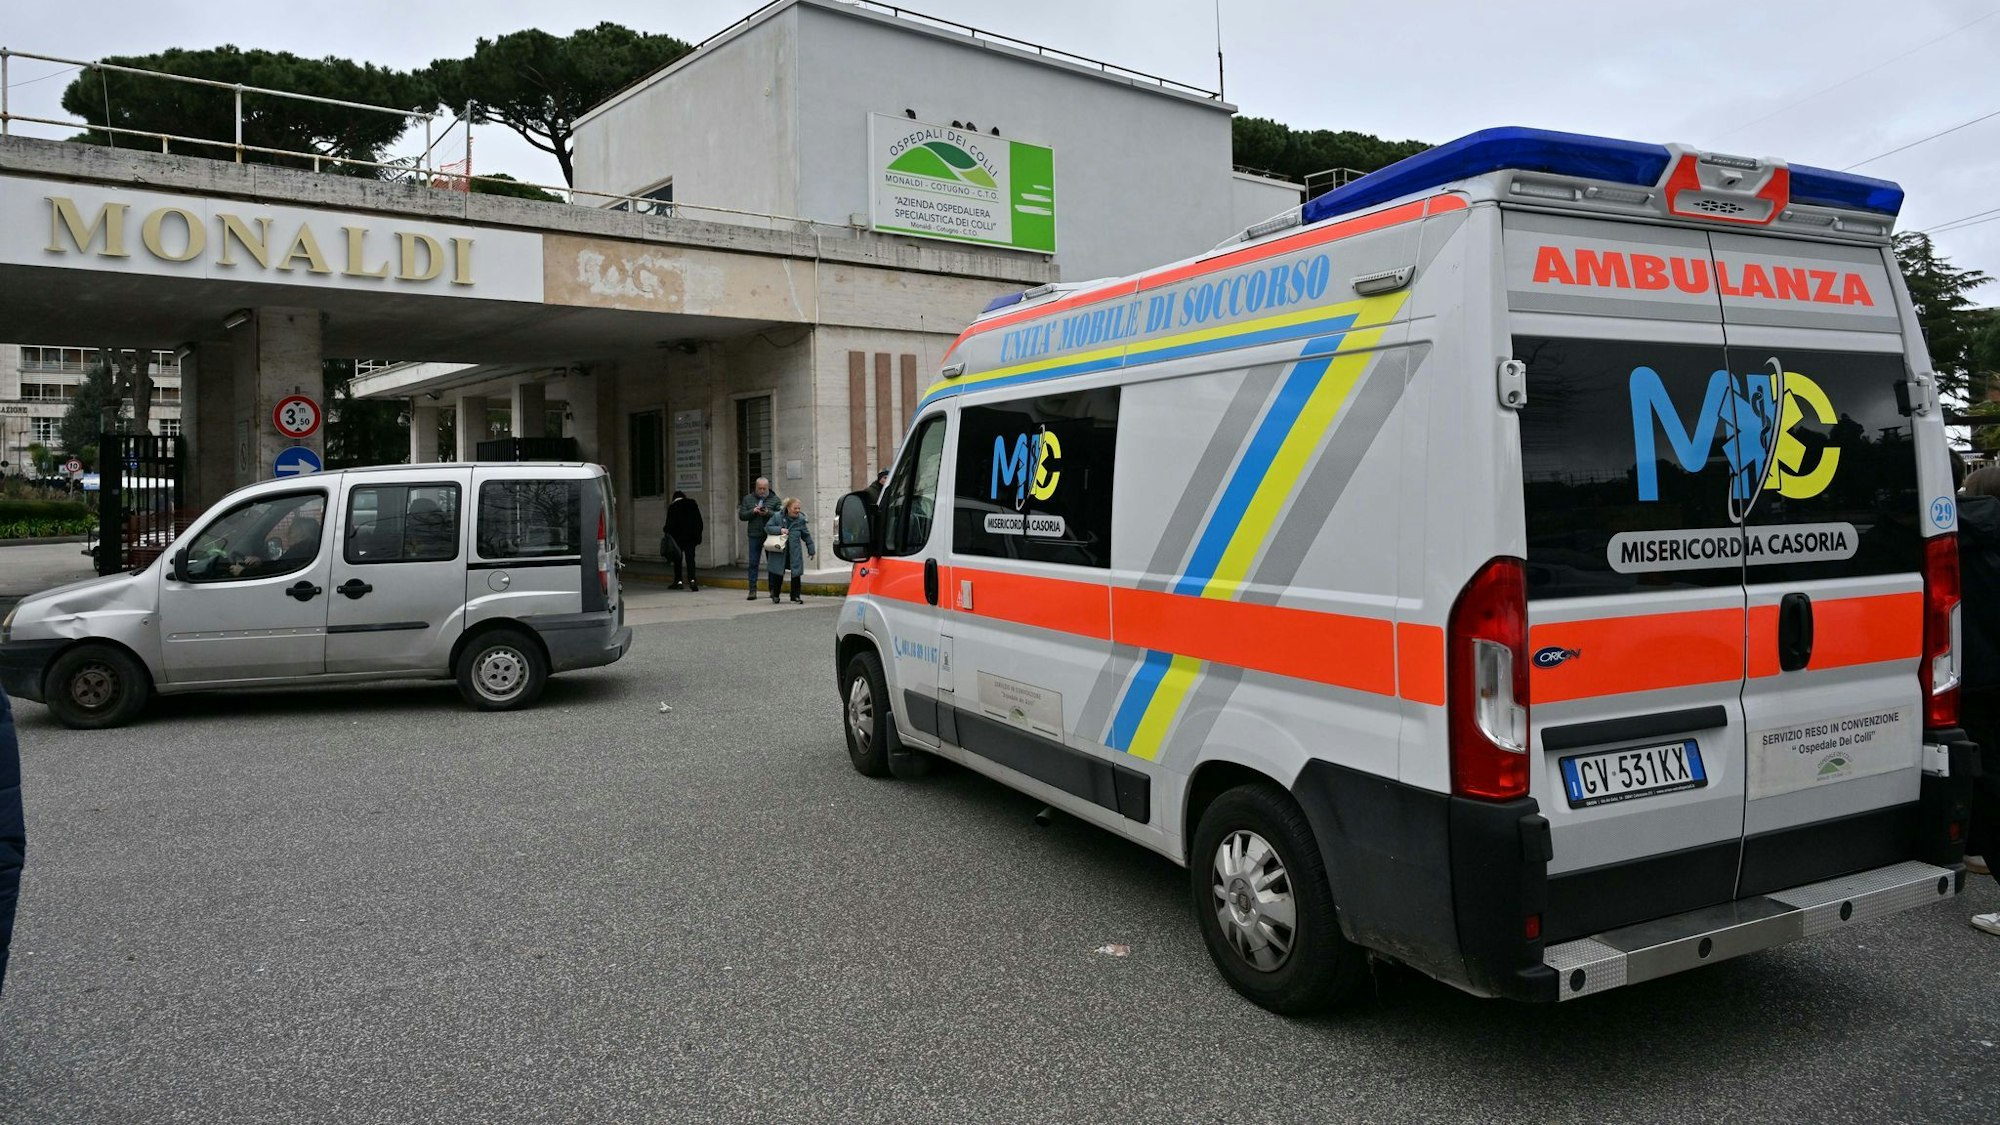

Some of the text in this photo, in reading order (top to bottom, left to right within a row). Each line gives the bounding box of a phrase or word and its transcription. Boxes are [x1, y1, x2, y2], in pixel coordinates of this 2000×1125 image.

[890, 129, 998, 178] OSPEDALI DEI COLLI
[885, 174, 923, 187] MONALDI
[931, 182, 970, 196] COTUGNO
[977, 189, 999, 200] C.T.O.
[894, 208, 954, 225] SPECIALISTICA
[955, 217, 971, 228] DEI
[937, 201, 991, 218] OSPEDALIERA
[910, 221, 930, 231] Monaldi
[936, 224, 959, 235] Cotugno
[44, 196, 476, 286] MONALDI
[1532, 246, 1875, 307] AMBULANZA
[1059, 301, 1141, 349] MOBILE
[1144, 291, 1178, 333] DI
[1179, 253, 1331, 328] SOCCORSO
[0, 406, 28, 414] AZIONE
[286, 409, 296, 425] 3
[70, 462, 78, 470] 10
[1935, 502, 1952, 522] 29
[988, 518, 1061, 532] MISERICORDIA CASORIA
[1621, 531, 1848, 564] MISERICORDIA CASORIA
[1762, 711, 1900, 746] SERVIZIO RESO IN CONVENZIONE
[1798, 740, 1837, 755] Ospedale
